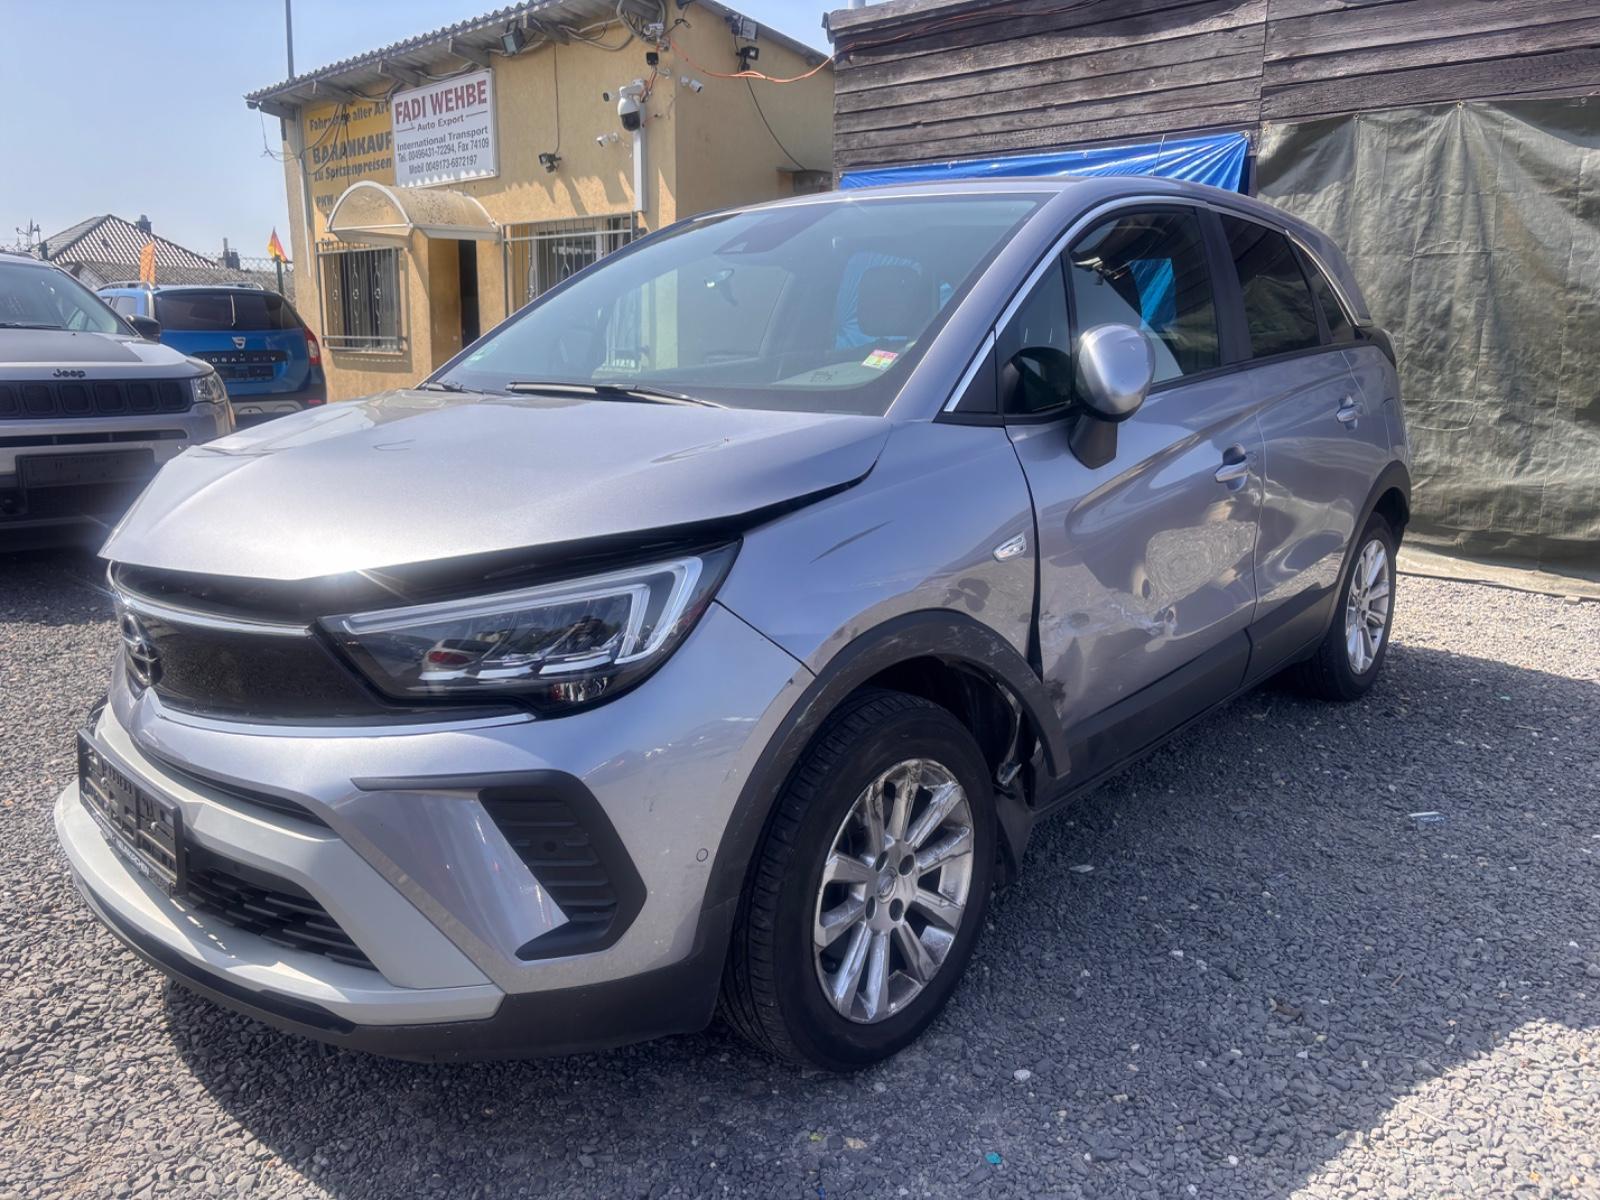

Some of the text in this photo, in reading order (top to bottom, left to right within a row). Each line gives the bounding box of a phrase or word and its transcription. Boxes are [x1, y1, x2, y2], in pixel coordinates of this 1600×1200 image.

[395, 80, 487, 125] FADI WEHBE
[353, 107, 372, 120] aller
[417, 115, 464, 132] Auto Export
[397, 126, 488, 152] International Transport
[457, 141, 469, 152] Fax
[470, 137, 489, 150] 74109
[53, 368, 86, 378] Jeep
